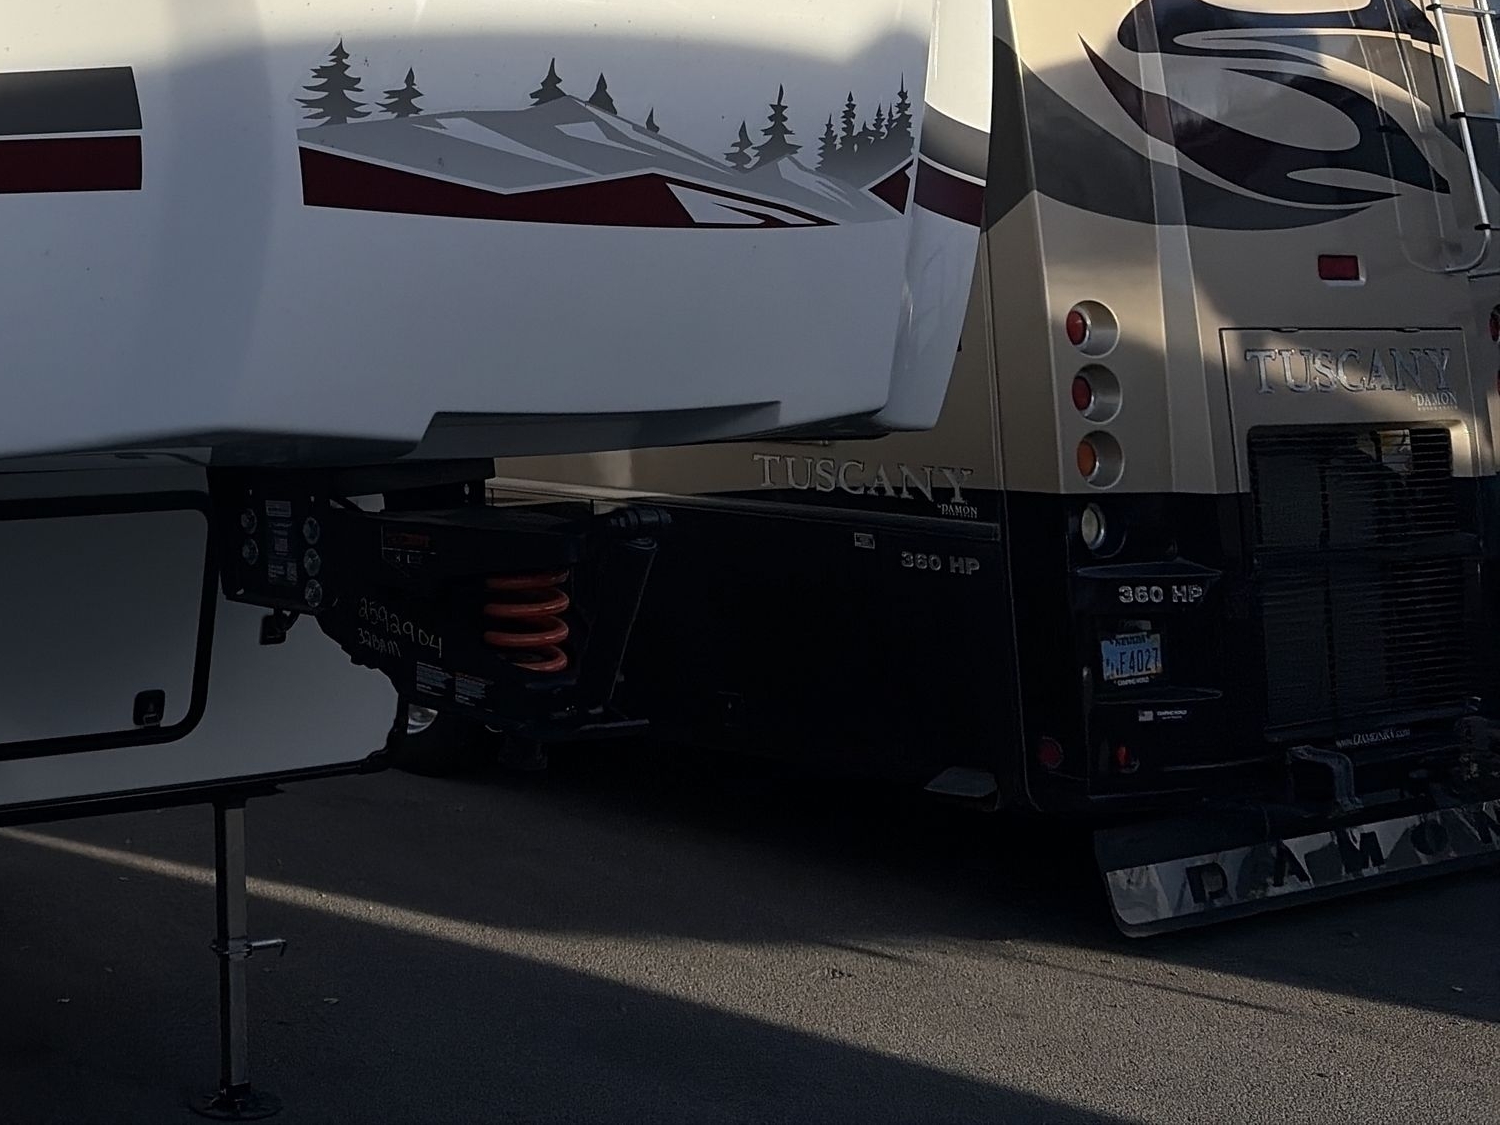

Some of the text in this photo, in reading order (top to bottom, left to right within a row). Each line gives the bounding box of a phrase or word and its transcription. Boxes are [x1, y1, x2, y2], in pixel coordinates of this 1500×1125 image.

[1245, 348, 1452, 394] TUSCANY
[752, 453, 974, 505] TUSCANY
[901, 551, 980, 575] 360 HP
[1118, 585, 1204, 603] 360 HP
